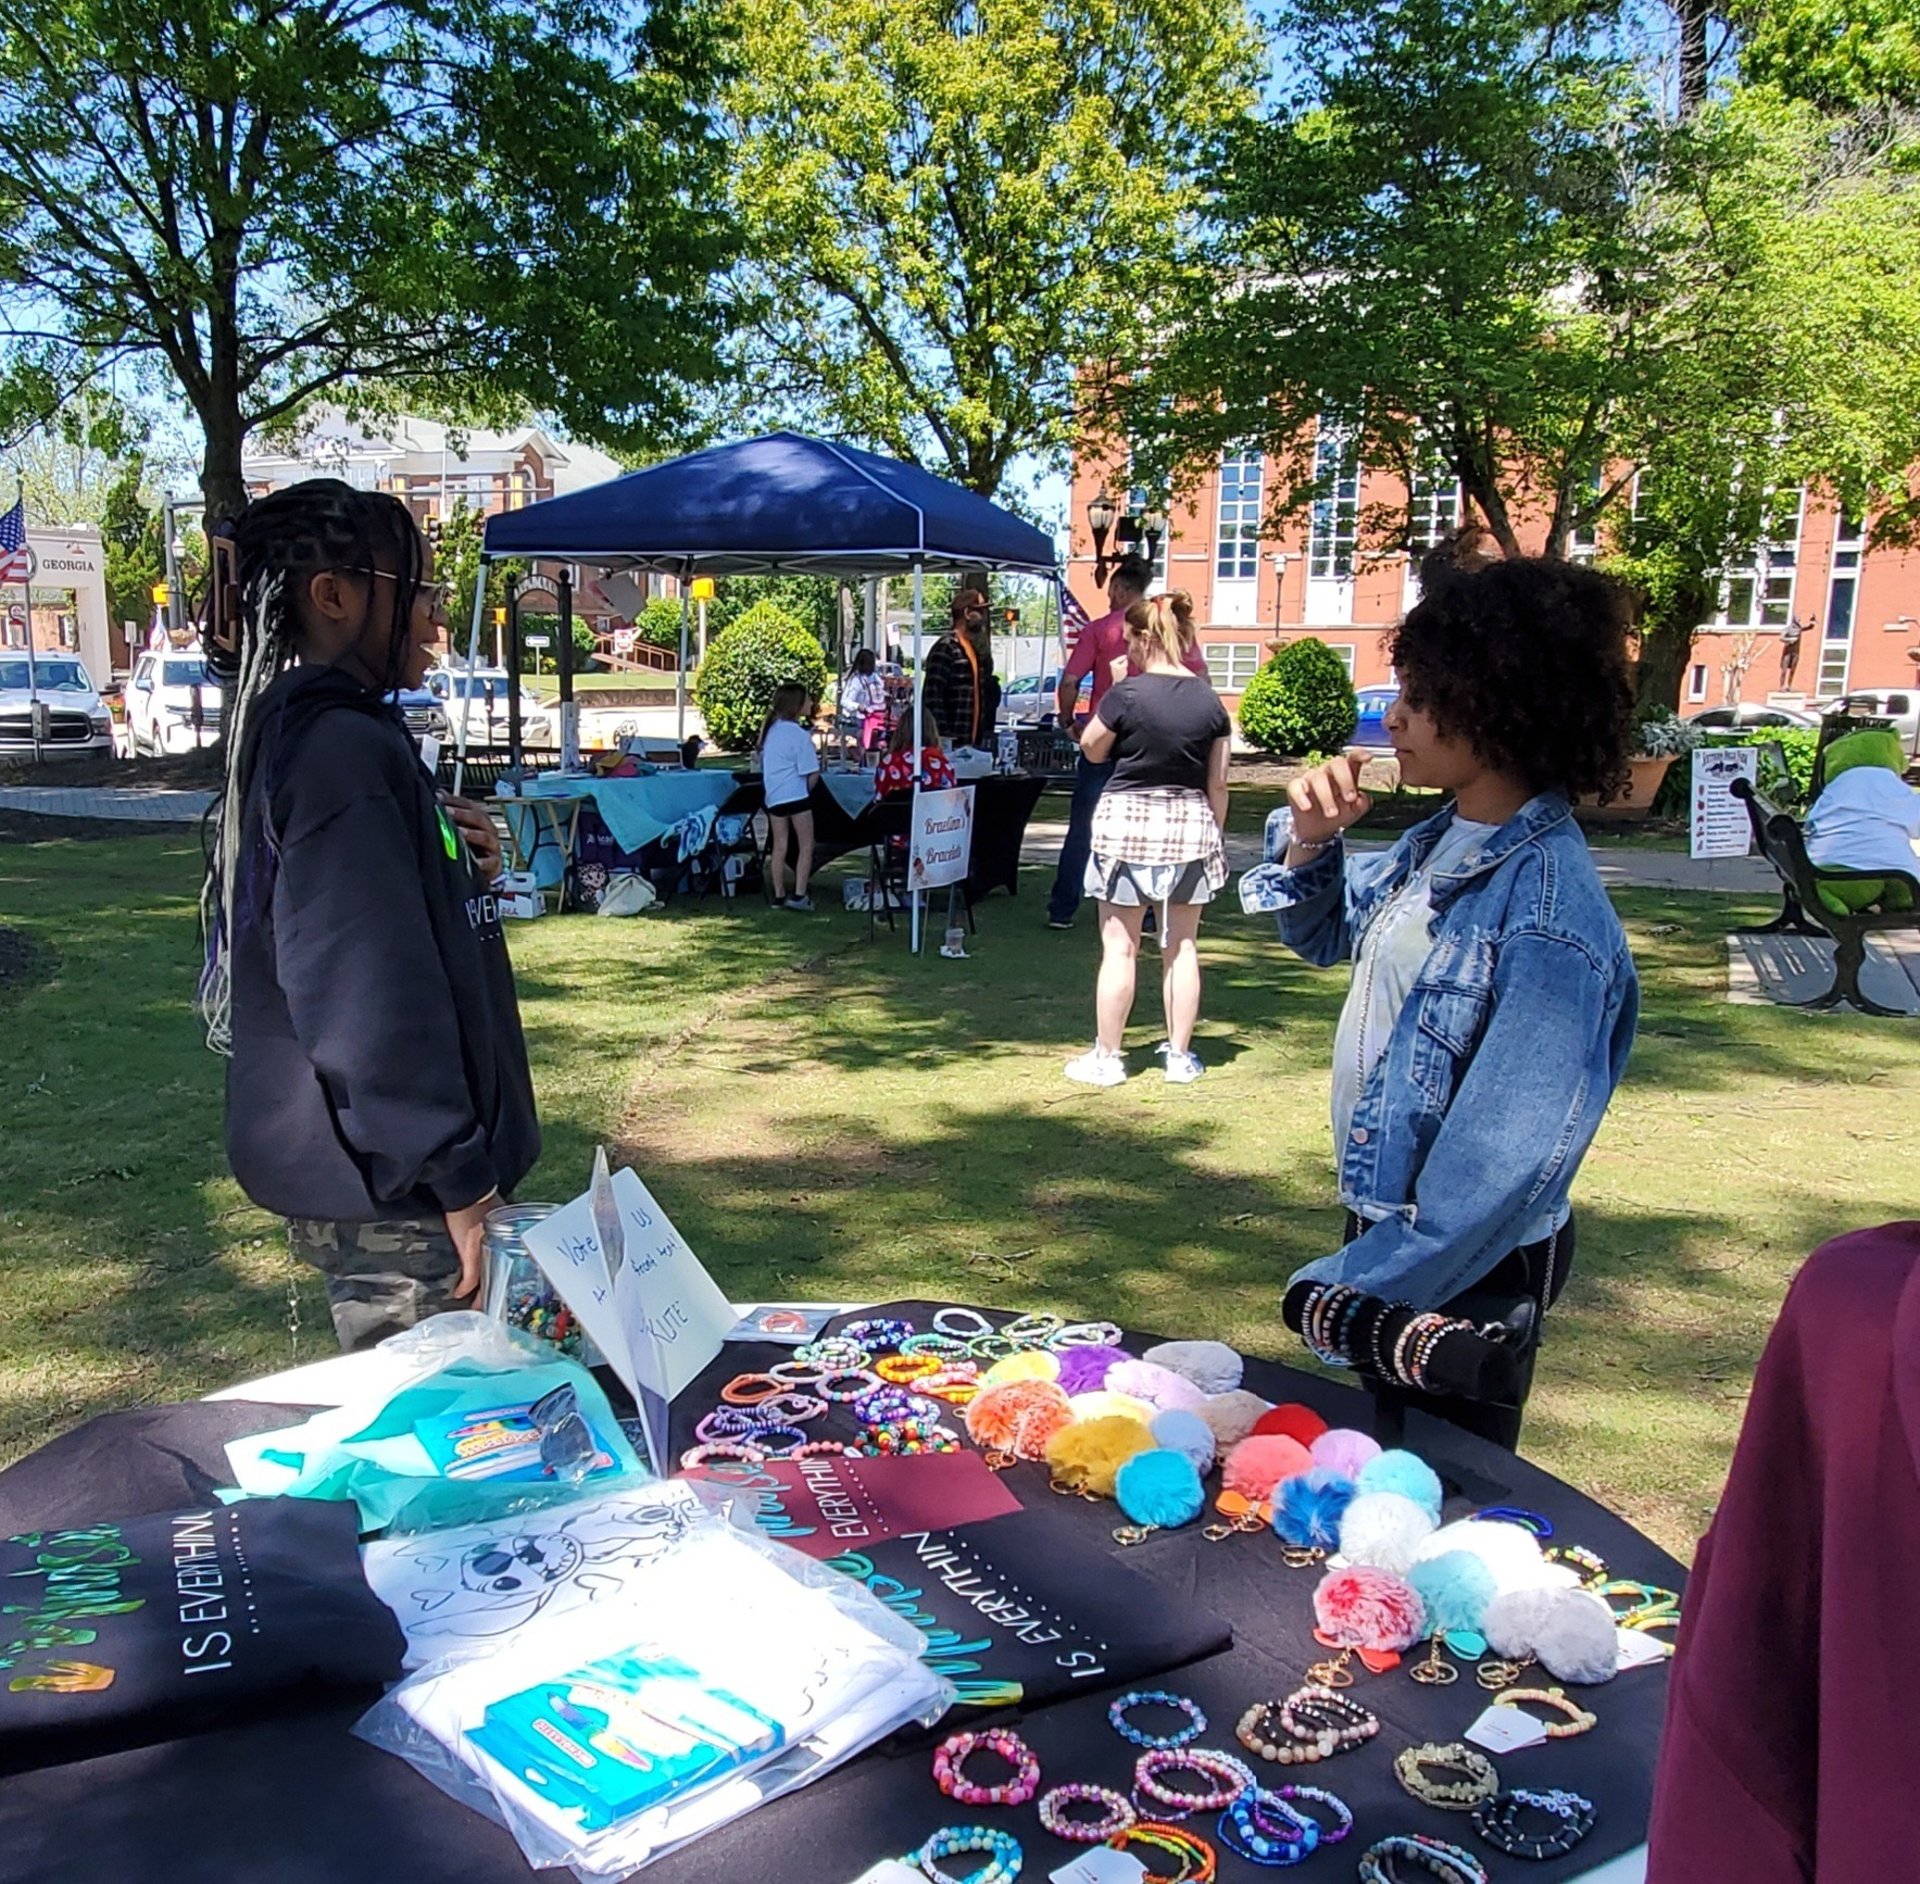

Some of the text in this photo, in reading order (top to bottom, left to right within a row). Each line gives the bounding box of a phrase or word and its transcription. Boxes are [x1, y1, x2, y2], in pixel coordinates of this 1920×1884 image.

[43, 558, 95, 572] GEORGIA
[556, 1236, 599, 1267] Vote
[461, 1428, 542, 1457] marke
[182, 1631, 232, 1674] IS
[1055, 1652, 1106, 1678] IS
